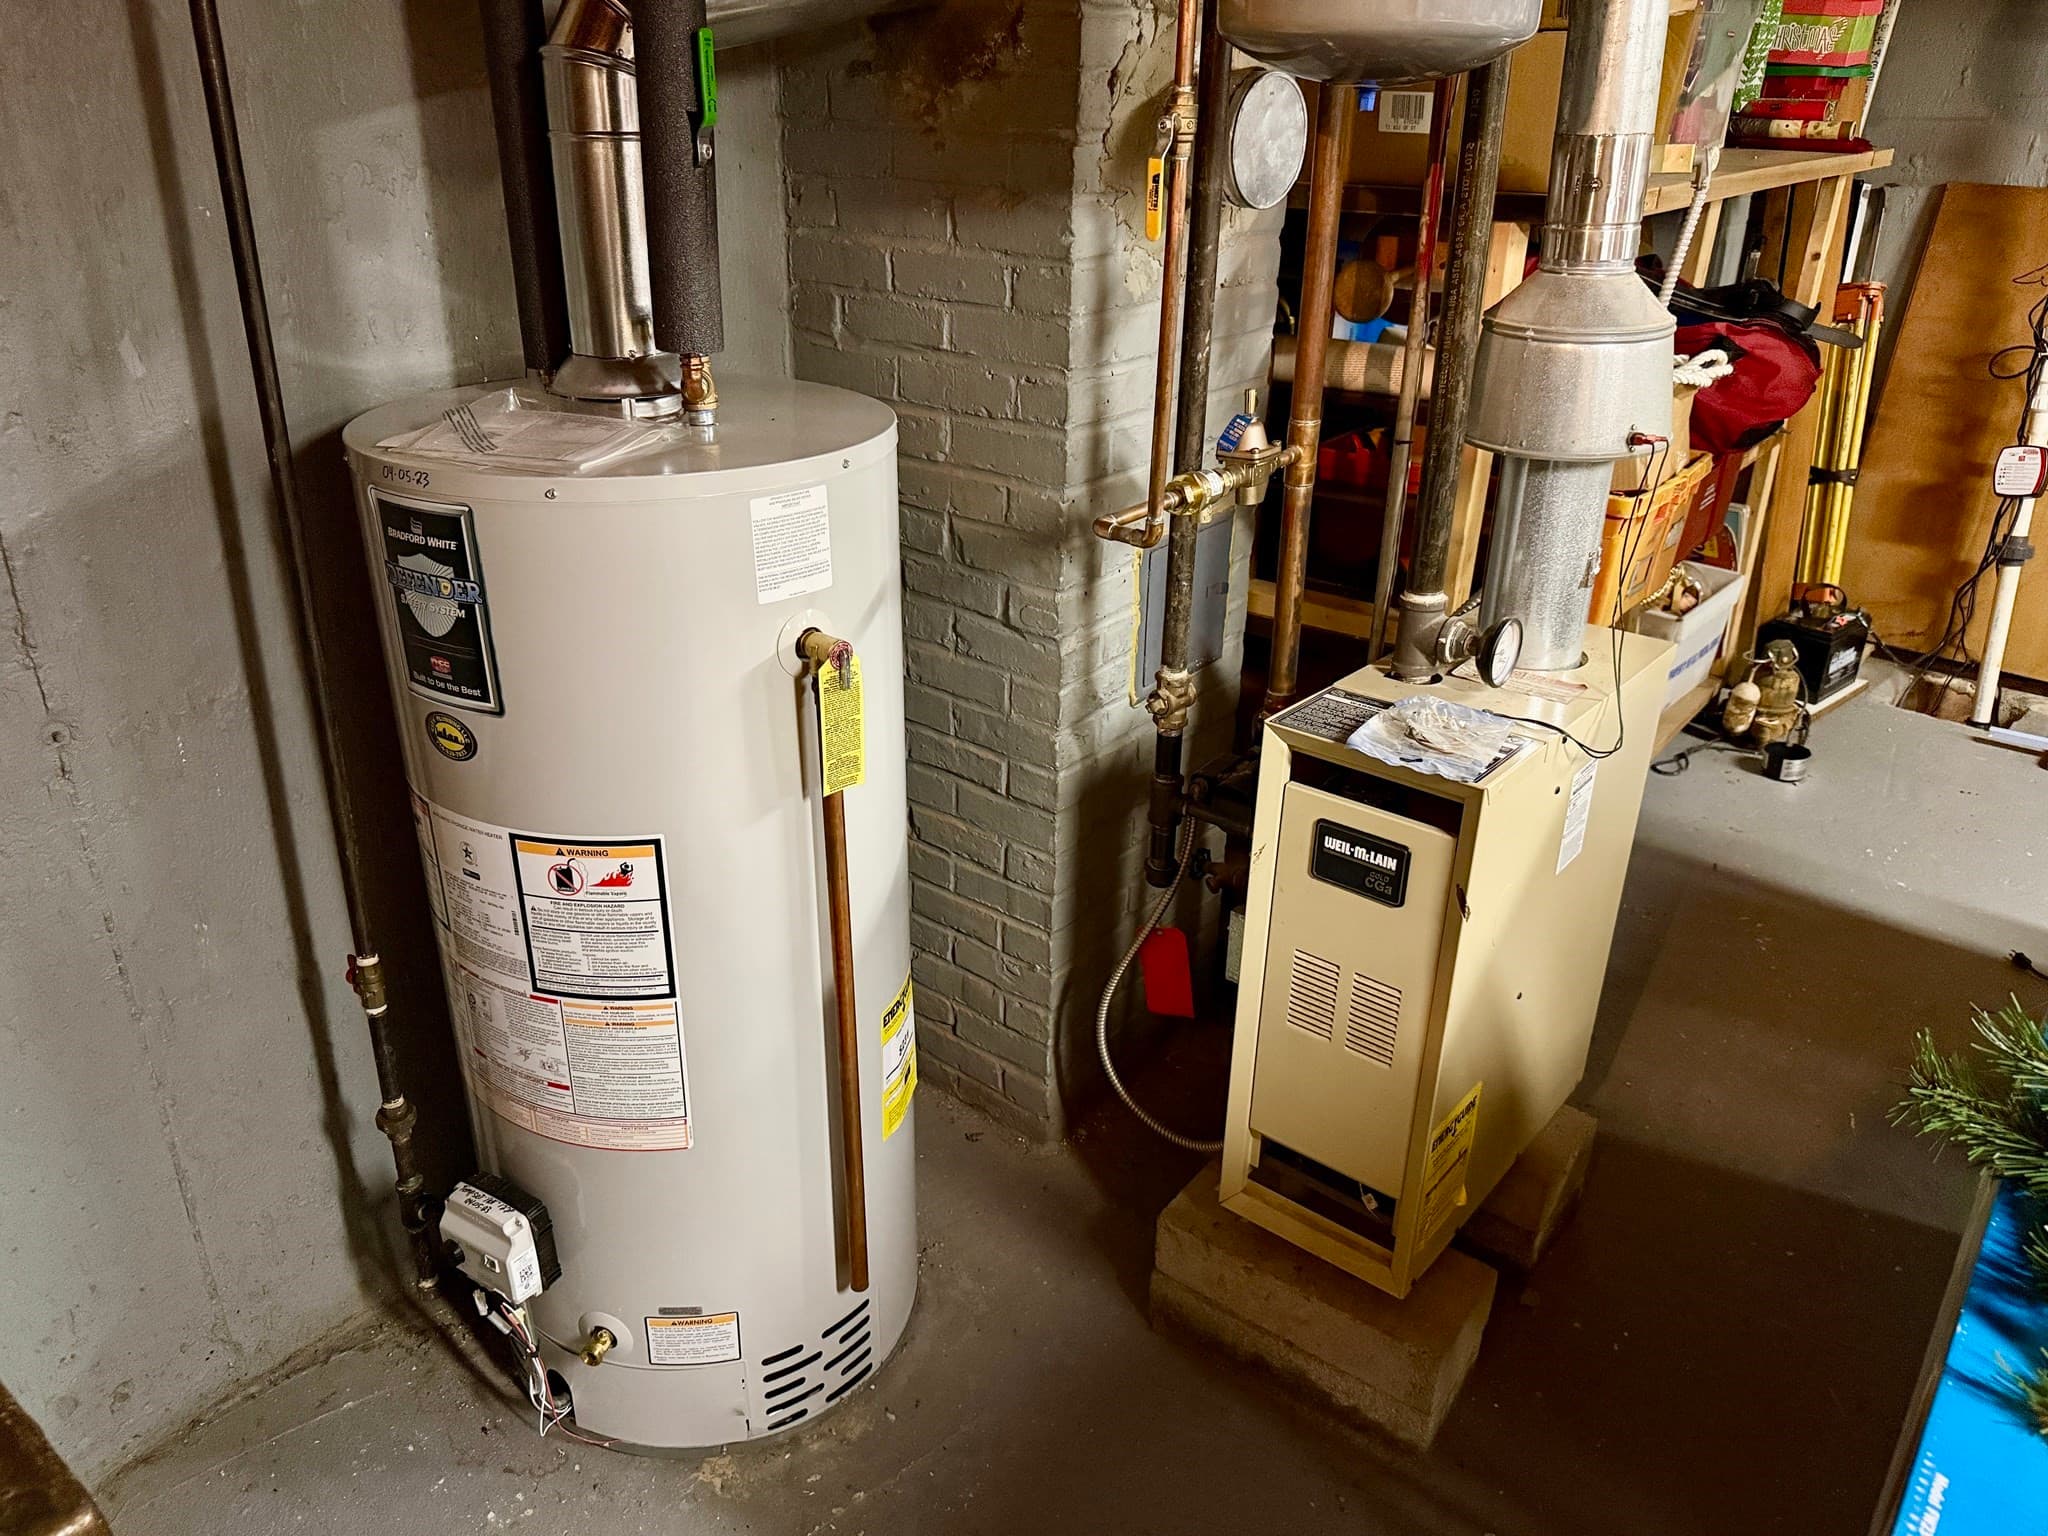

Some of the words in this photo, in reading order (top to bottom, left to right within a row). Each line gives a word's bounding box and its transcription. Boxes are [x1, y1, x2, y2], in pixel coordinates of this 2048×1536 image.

[387, 526, 426, 545] BRADFORD
[426, 536, 457, 551] WHITE
[385, 560, 483, 604] DEFENDER
[429, 602, 466, 618] SYSTEM
[446, 682, 460, 692] the
[461, 685, 481, 696] Best
[566, 849, 609, 857] WARNING
[1364, 877, 1393, 896] CGa
[678, 1318, 713, 1326] WARNING
